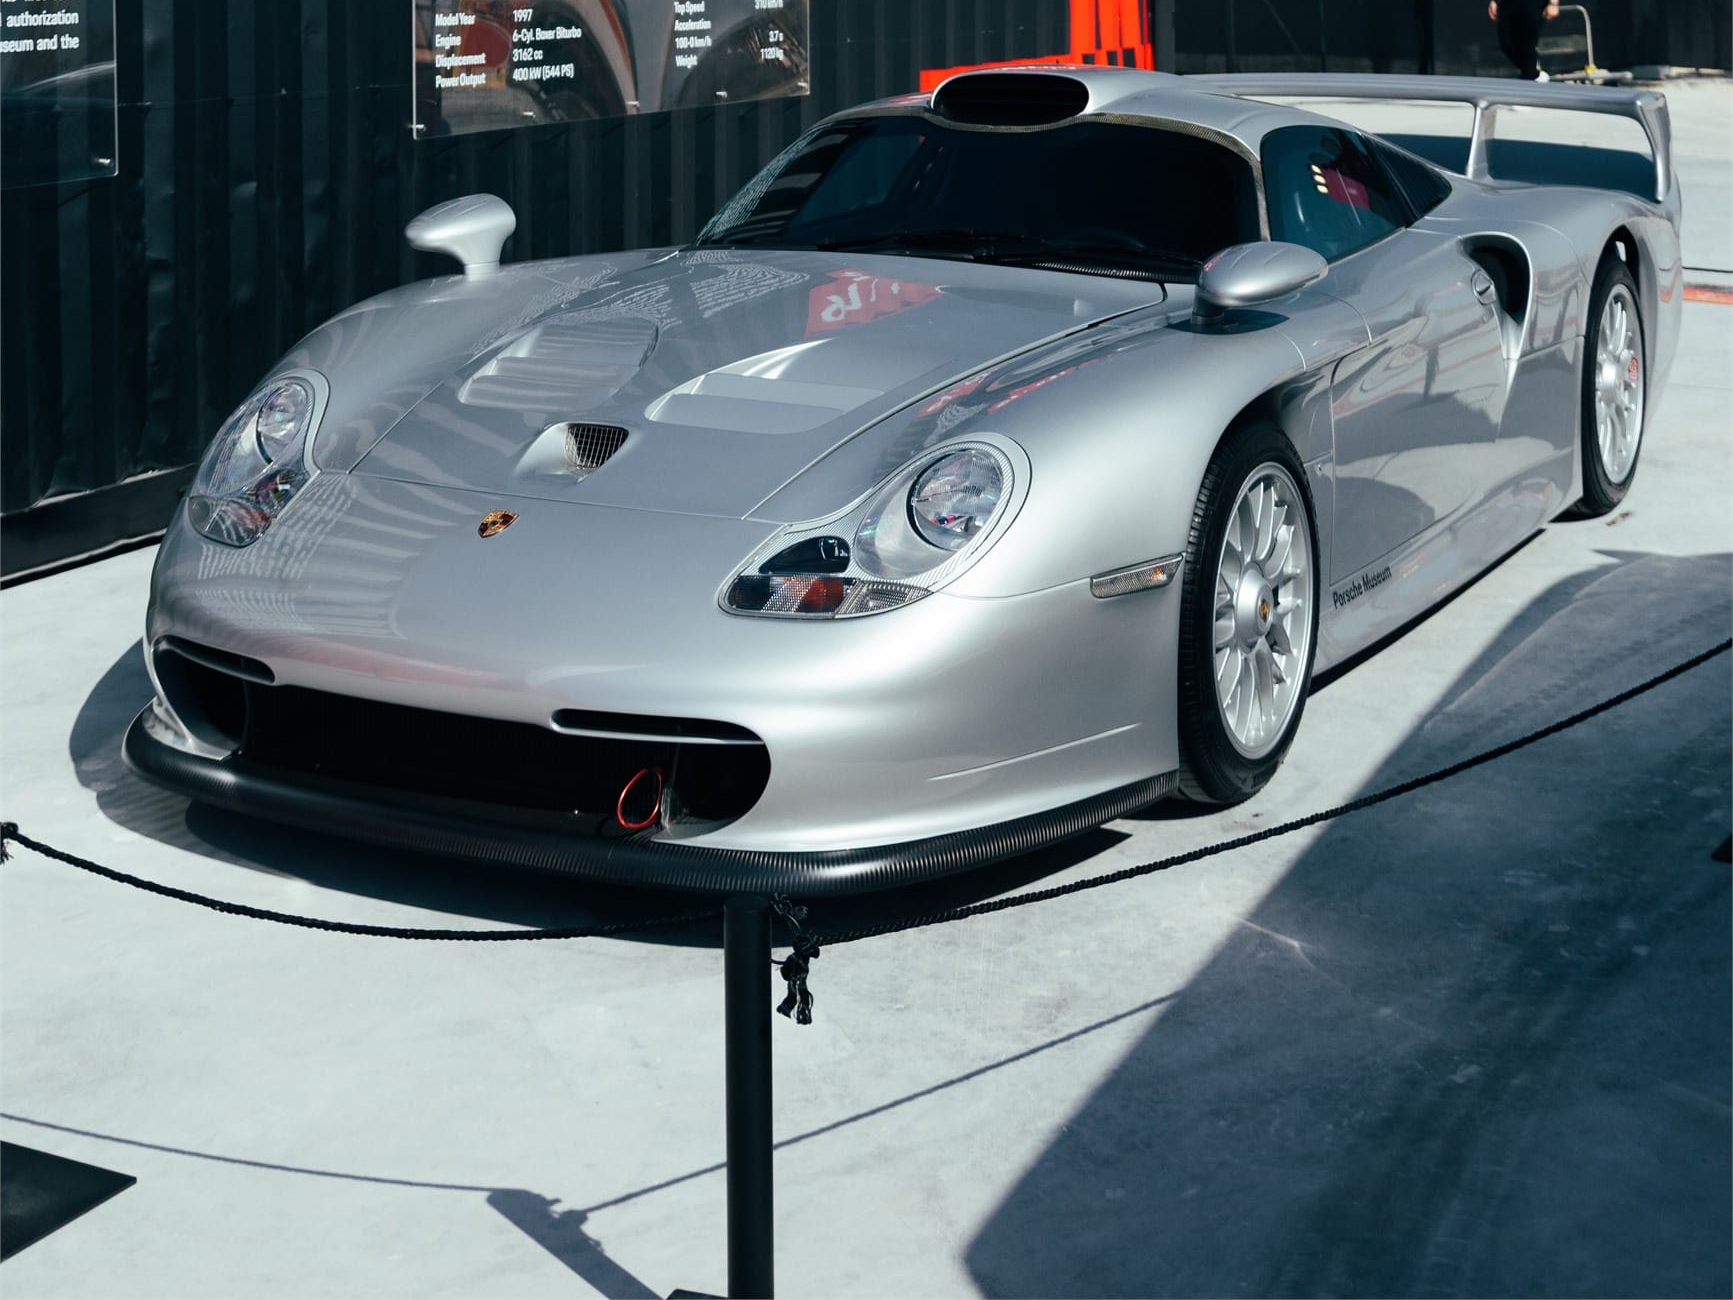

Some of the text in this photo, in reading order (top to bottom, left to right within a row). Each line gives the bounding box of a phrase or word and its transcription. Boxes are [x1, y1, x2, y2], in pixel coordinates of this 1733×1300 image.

[673, 0, 705, 15] Top Speed
[6, 9, 79, 27] authorization
[435, 12, 476, 27] Model Year
[512, 9, 533, 22] 1997
[674, 18, 712, 31] Acceleration
[36, 34, 58, 51] and
[60, 33, 80, 49] the
[435, 33, 462, 50] Engine
[512, 26, 582, 44] 6-Cyl. Boxer Biturbo
[694, 35, 712, 47] km/h
[768, 30, 779, 42] 3.7
[435, 53, 486, 70] Displacement
[512, 47, 544, 62] 3162 cc
[675, 54, 698, 69] Weight
[760, 47, 784, 61] 1120 kg
[512, 64, 574, 81] 400 kW (544 PS)
[435, 73, 486, 88] Power Output
[1332, 566, 1392, 610] Porsche Museum
